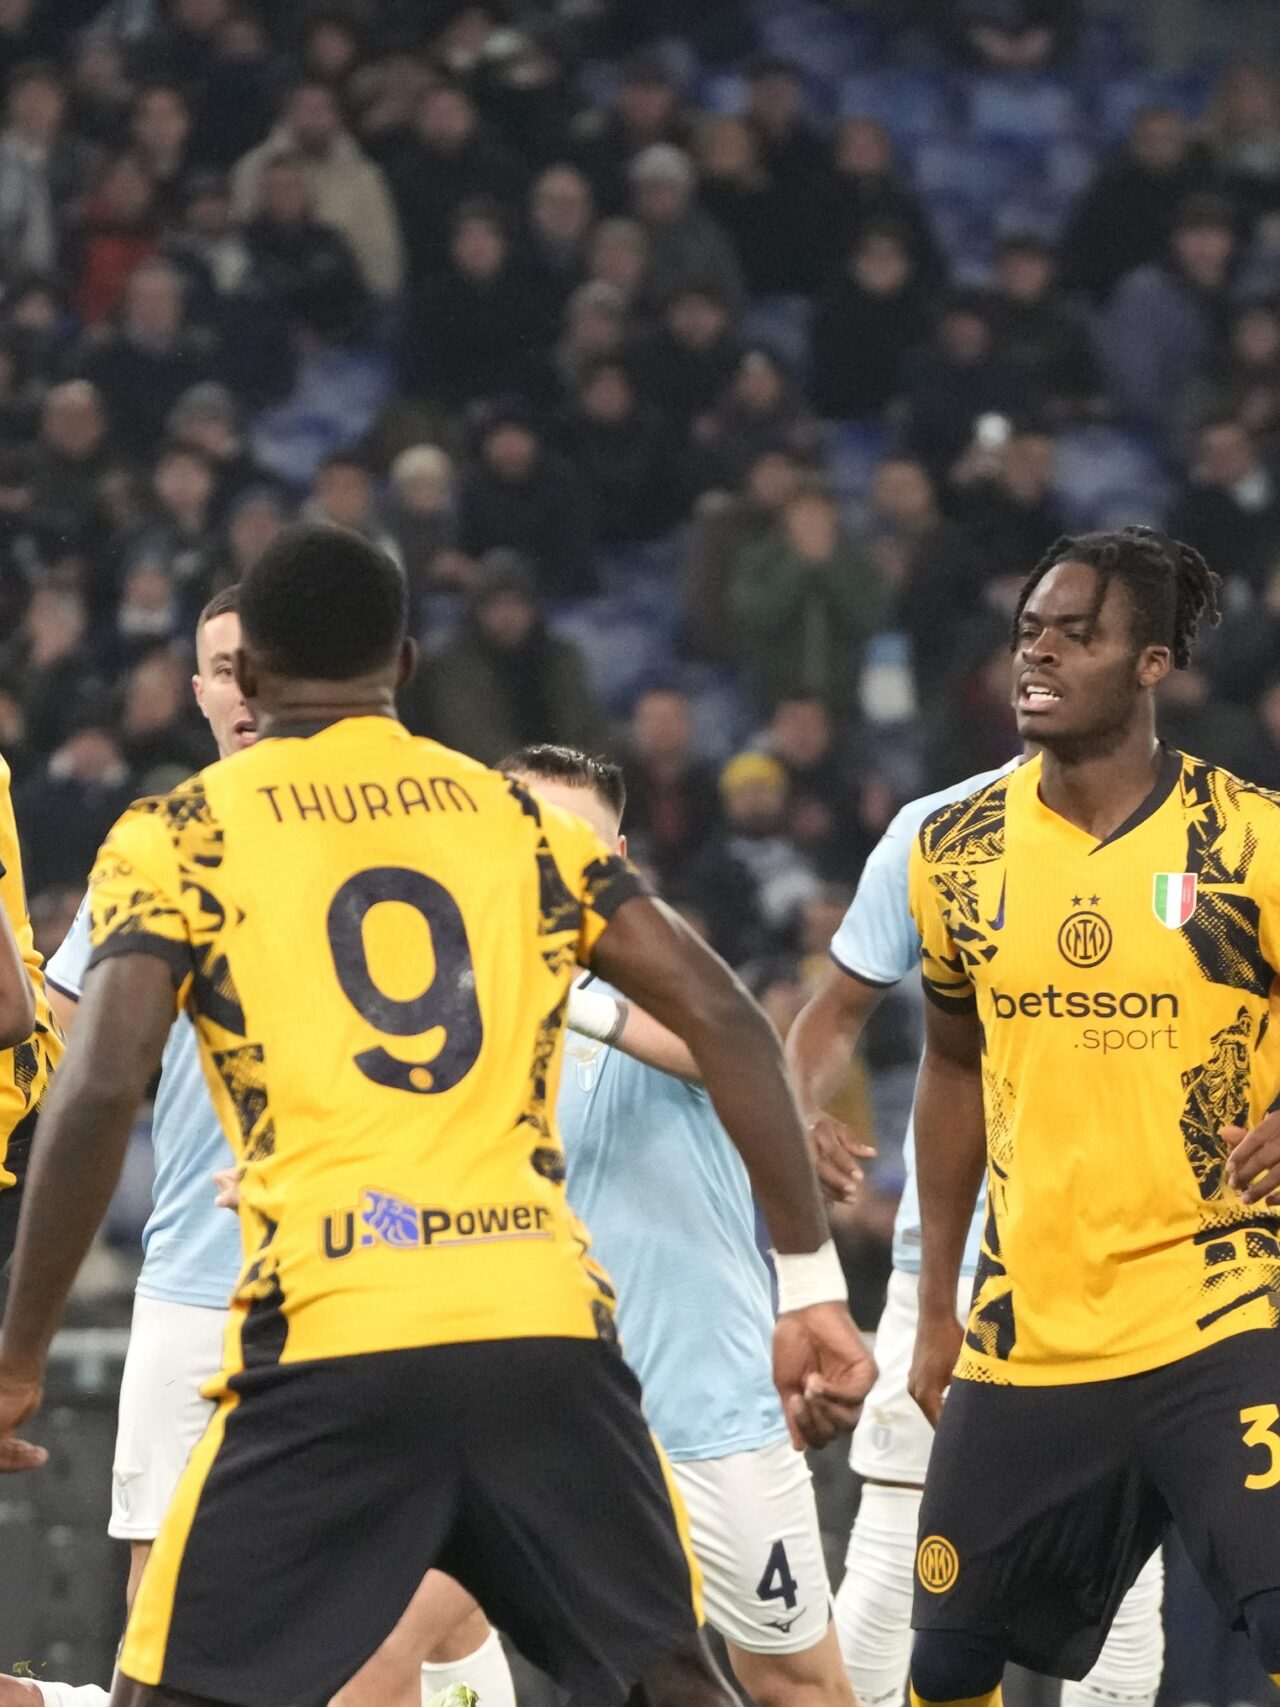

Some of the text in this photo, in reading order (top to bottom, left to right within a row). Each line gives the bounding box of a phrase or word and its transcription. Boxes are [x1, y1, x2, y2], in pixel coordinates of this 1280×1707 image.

[257, 776, 479, 824] THURAM
[326, 865, 484, 1095] 9
[989, 984, 1179, 1019] betsson
[1073, 1024, 1179, 1055] .sport
[422, 1204, 550, 1245] Power
[1239, 1403, 1280, 1490] 3
[755, 1538, 798, 1611] 4
